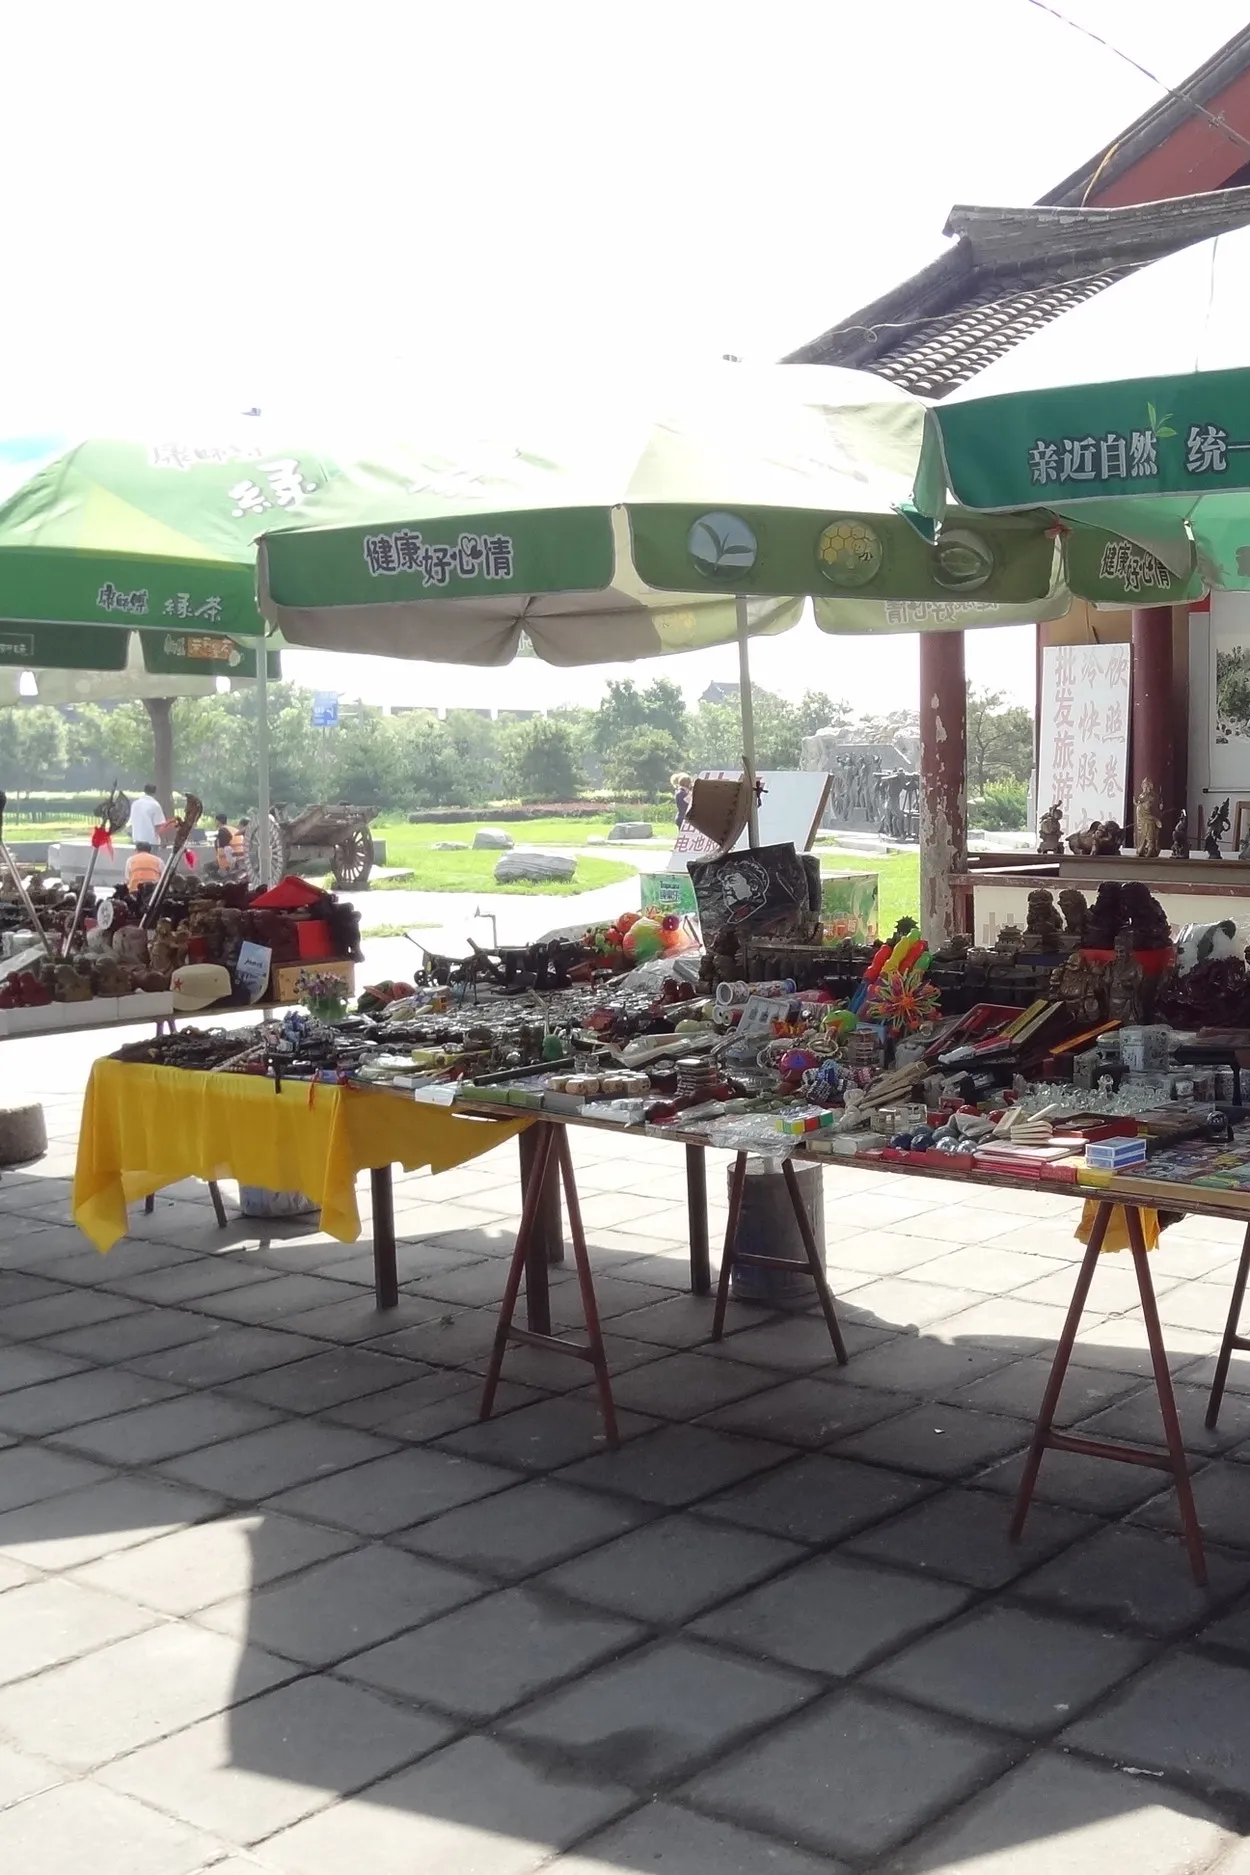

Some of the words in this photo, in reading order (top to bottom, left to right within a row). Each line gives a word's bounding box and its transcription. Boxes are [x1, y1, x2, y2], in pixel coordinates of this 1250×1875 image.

[1028, 431, 1159, 484] 亲近自然
[364, 530, 514, 586] 健康好心情
